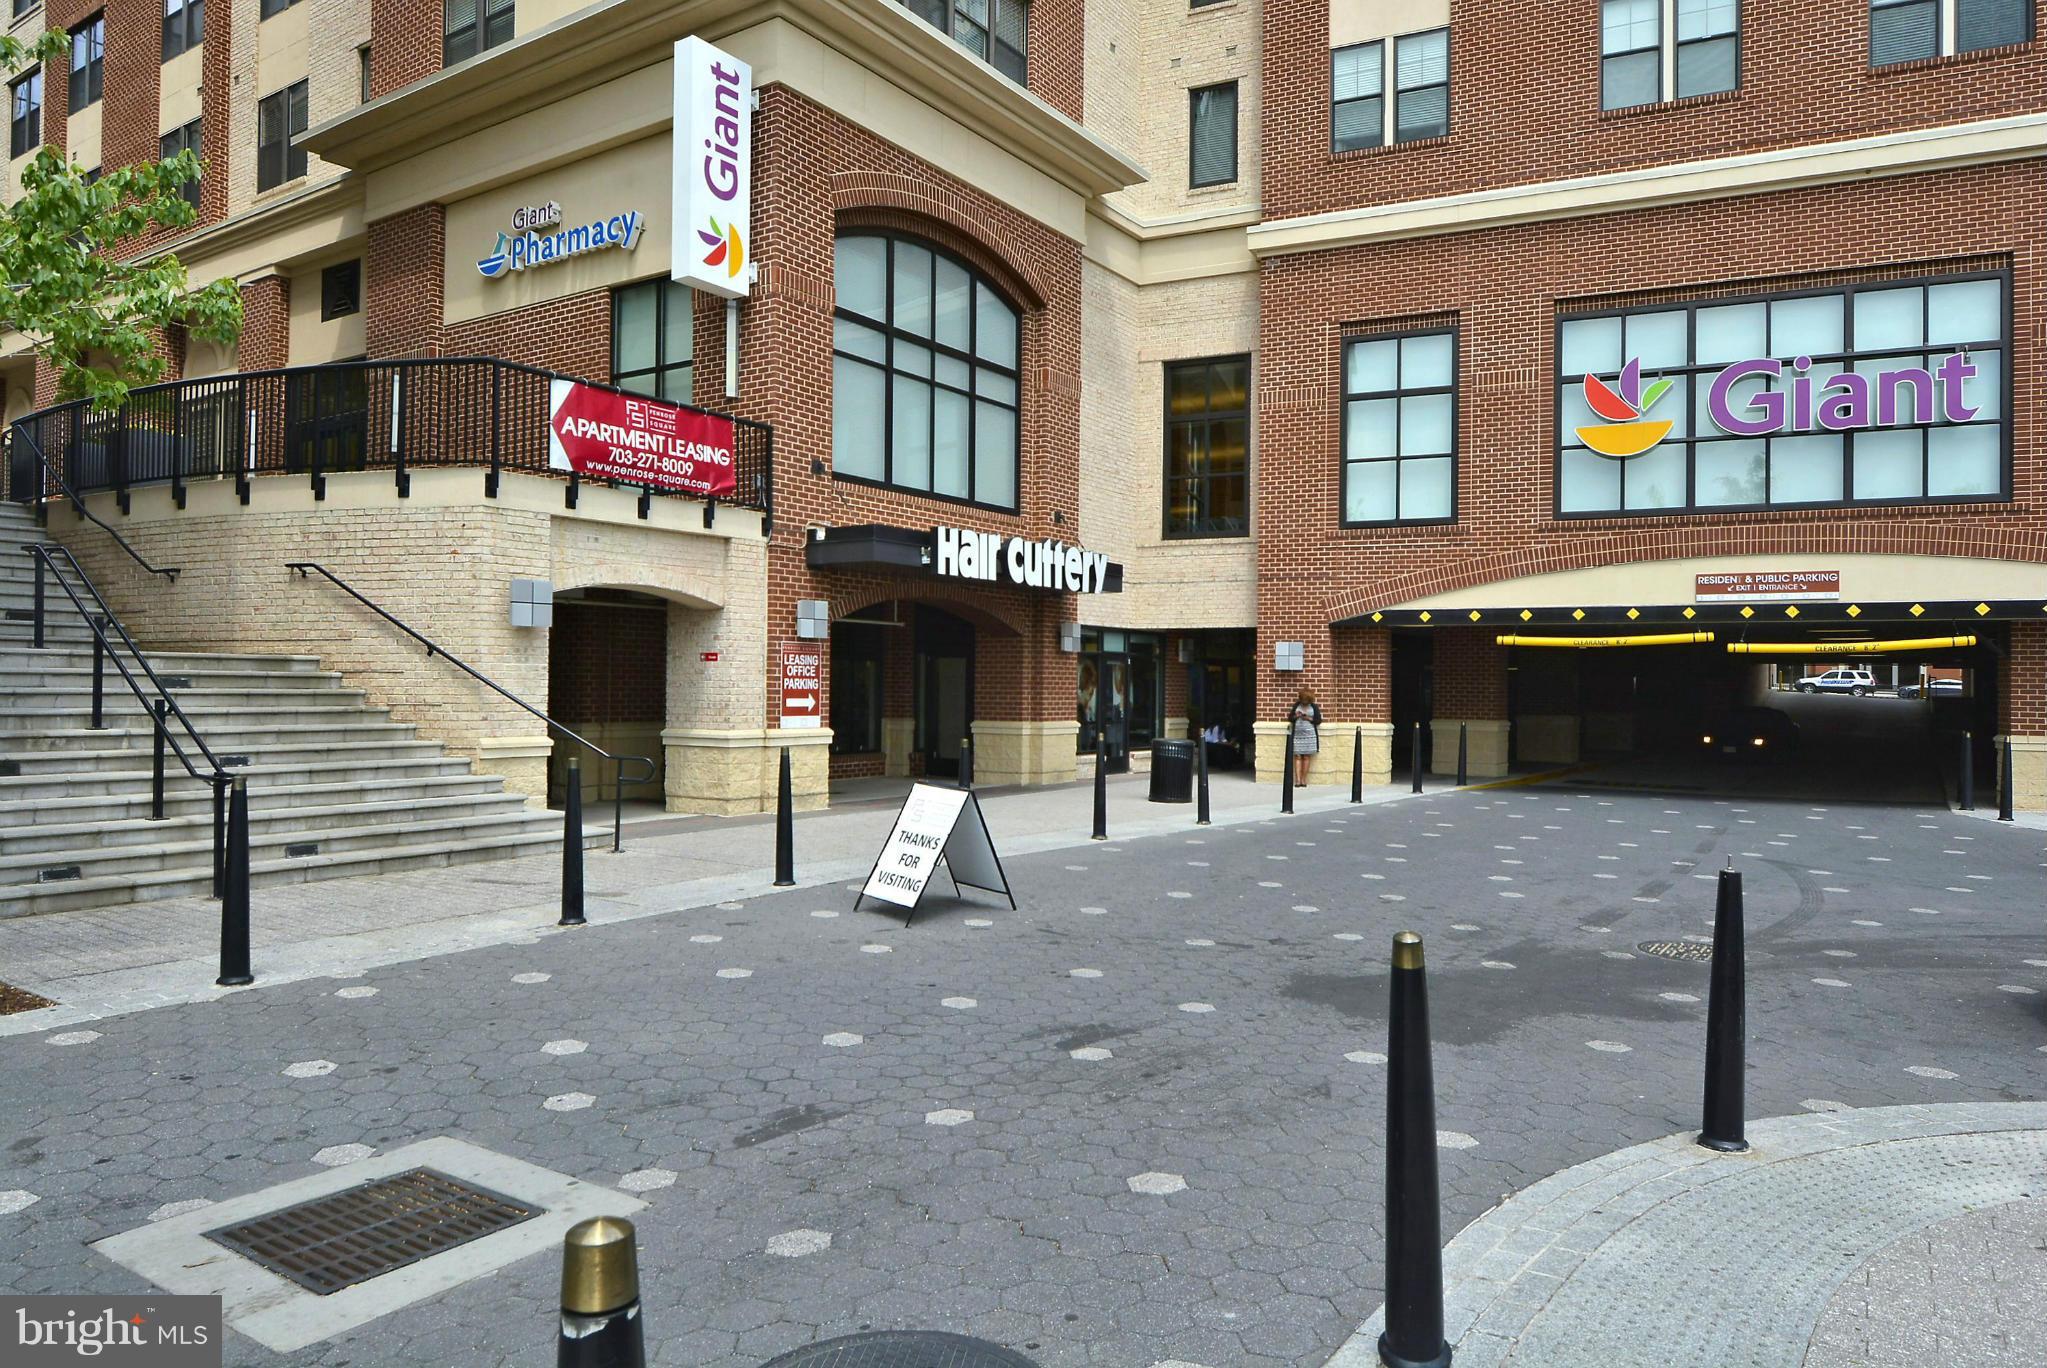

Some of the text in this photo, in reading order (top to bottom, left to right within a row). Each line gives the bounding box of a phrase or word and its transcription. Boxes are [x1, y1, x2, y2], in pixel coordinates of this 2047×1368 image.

[704, 61, 740, 202] Giant
[512, 201, 554, 230] Giant
[510, 210, 637, 270] Pharmacy
[1707, 352, 1984, 436] Giant
[649, 409, 677, 420] PENROSE
[649, 420, 677, 431] SQUARE
[560, 416, 731, 467] APARTMENT LEASING
[608, 446, 694, 476] 703-271-8009
[586, 461, 711, 490] www.penrose-square.com
[937, 525, 1110, 594] Hair Cuttery
[1736, 583, 1798, 592] EXIT ENTRANCE
[1755, 574, 1790, 583] PUBLIC
[1792, 573, 1838, 582] PARKING
[783, 654, 819, 666] LEASING
[786, 665, 816, 677] OFFICE
[783, 678, 819, 690] PARKING
[898, 830, 941, 850] THANKS
[898, 853, 921, 869] FOR
[877, 871, 923, 893] VISITING
